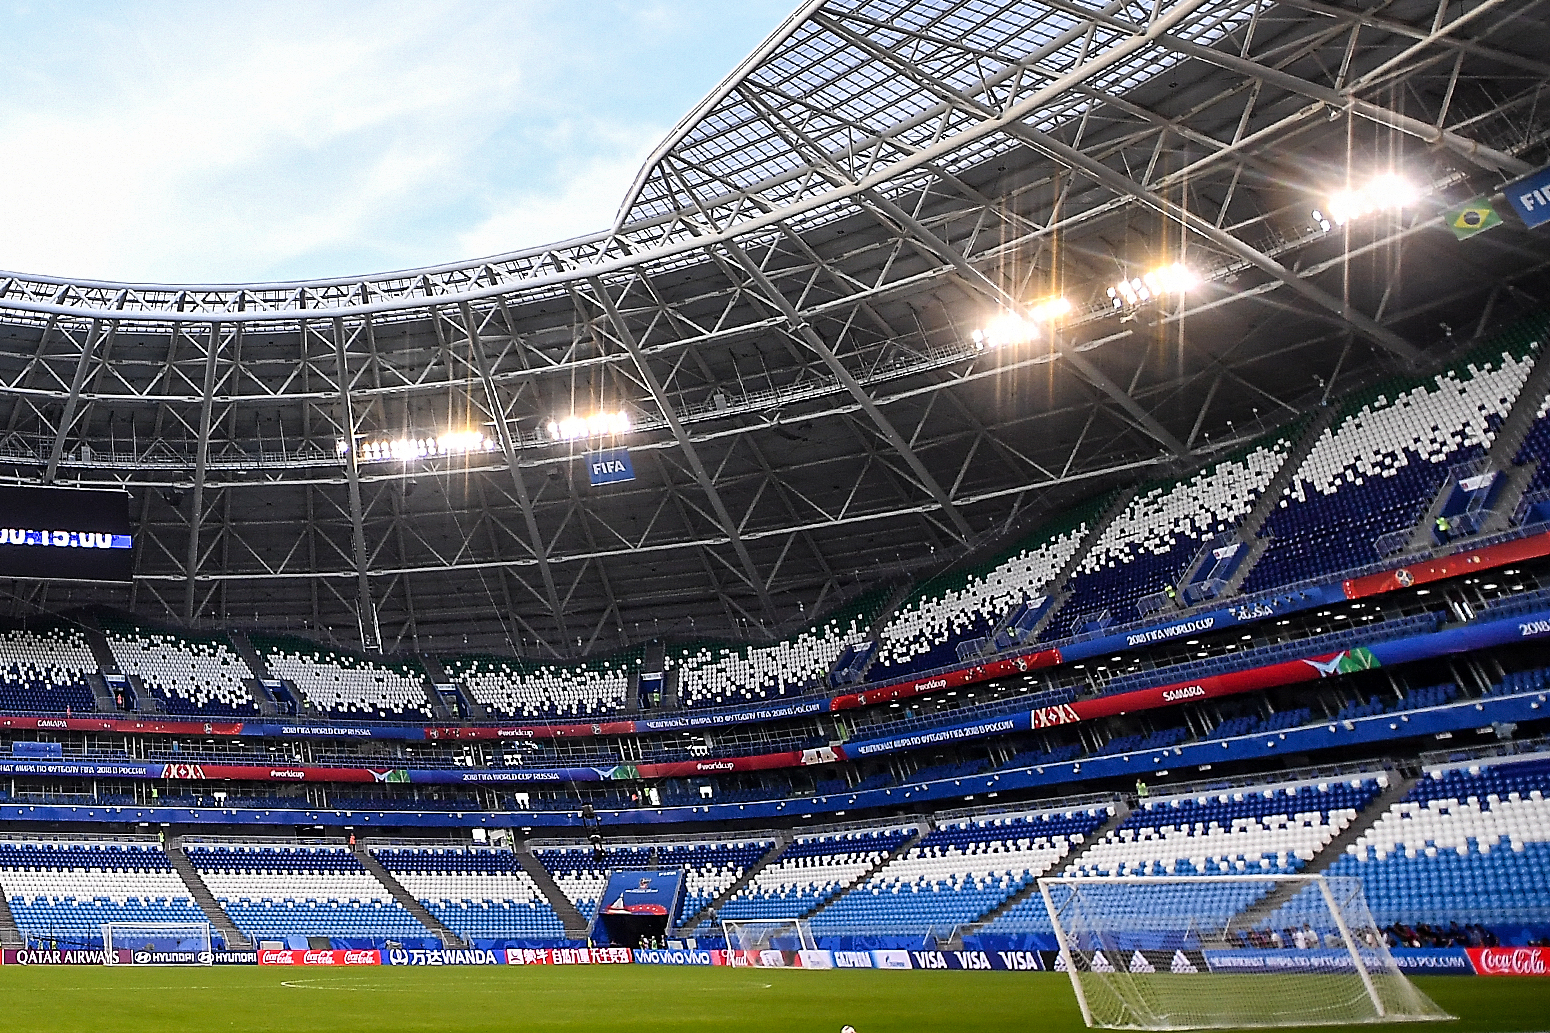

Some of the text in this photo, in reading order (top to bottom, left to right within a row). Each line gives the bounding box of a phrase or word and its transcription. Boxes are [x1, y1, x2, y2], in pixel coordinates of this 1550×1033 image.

[592, 460, 626, 475] FIFA
[1127, 634, 1146, 646] 2018
[1147, 630, 1165, 643] FIFA
[1164, 623, 1196, 638] WORLD
[1196, 617, 1214, 629] CUP
[1519, 621, 1550, 636] 2018
[1162, 685, 1205, 701] SAMARA
[37, 719, 67, 728] САМАРА
[311, 727, 333, 735] WORLD
[497, 729, 533, 738] #worldcup
[270, 769, 305, 779] #worldcup
[463, 773, 478, 781] 2018
[493, 773, 517, 781] WORLD
[16, 950, 120, 965] QATAR AIRWAYS
[152, 952, 194, 962] HYUNDAI
[215, 952, 257, 962] HYUNDAI
[441, 949, 498, 965] WANDA
[912, 951, 948, 969] VISA
[954, 951, 991, 969] VISA
[997, 951, 1038, 969] VISA
[1481, 948, 1547, 974] Coca-Cola
